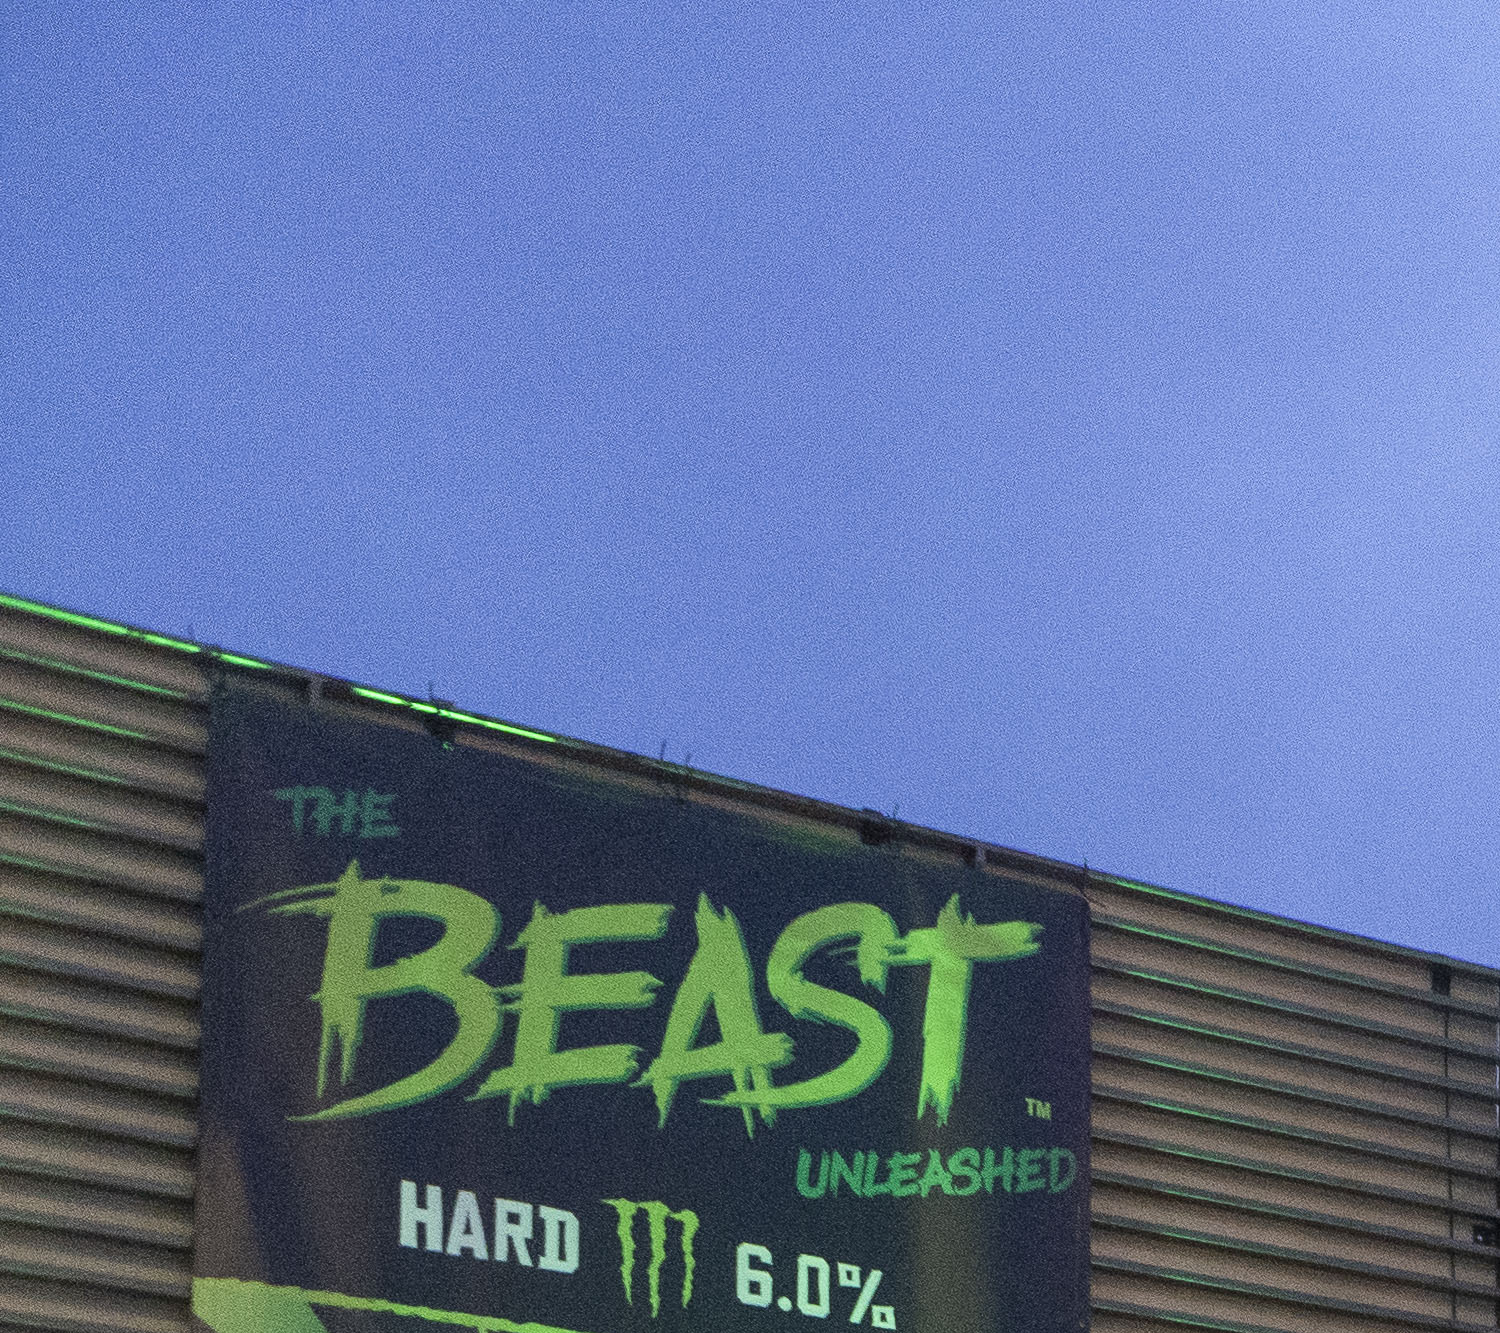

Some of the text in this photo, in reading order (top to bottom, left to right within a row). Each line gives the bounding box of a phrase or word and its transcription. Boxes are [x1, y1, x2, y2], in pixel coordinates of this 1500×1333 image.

[274, 786, 401, 839] THE
[236, 860, 1042, 1138] BEAST
[796, 1146, 1077, 1199] UNLEASHED
[401, 1180, 896, 1331] HARD 6.0%
